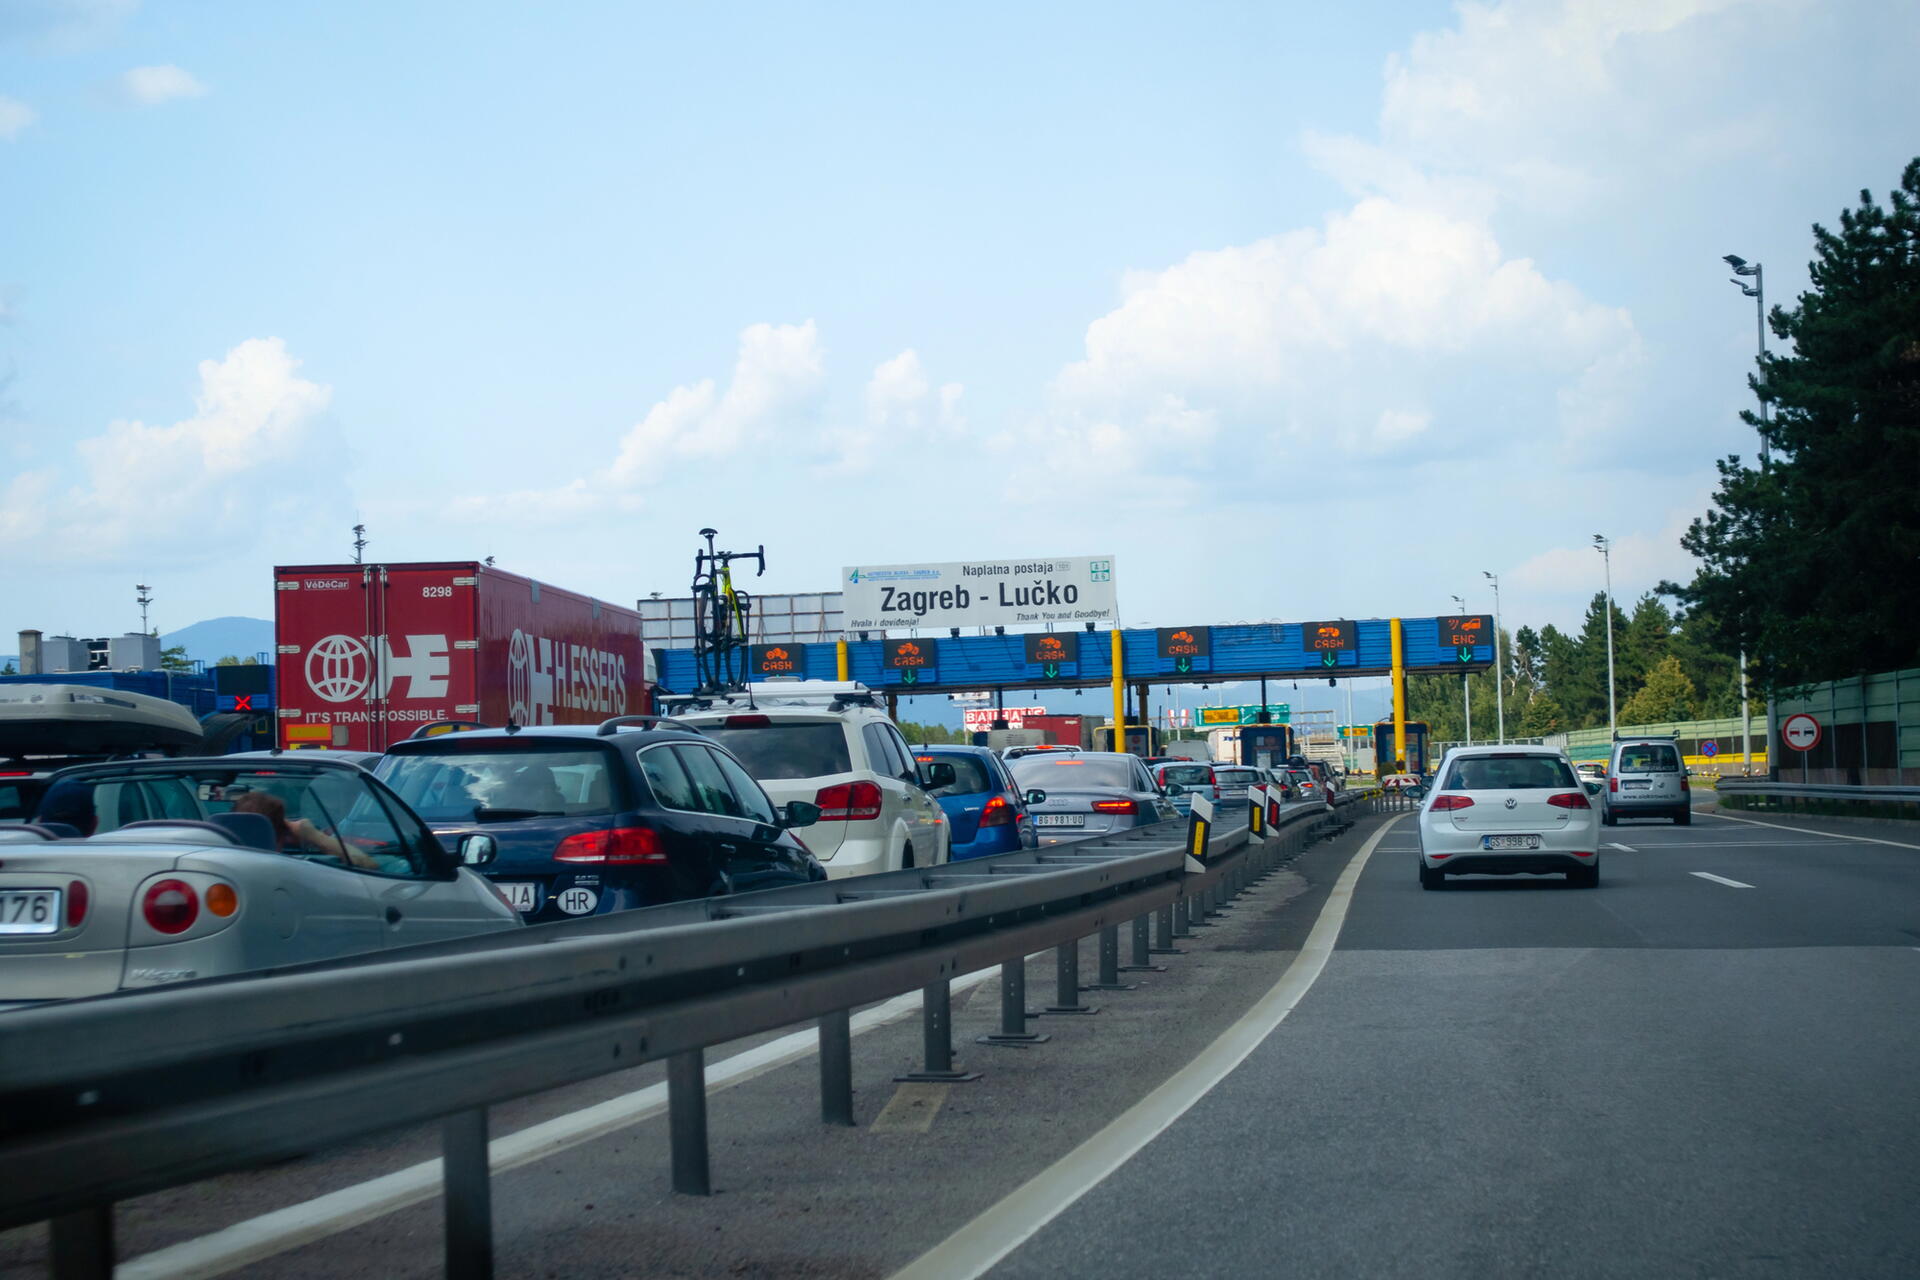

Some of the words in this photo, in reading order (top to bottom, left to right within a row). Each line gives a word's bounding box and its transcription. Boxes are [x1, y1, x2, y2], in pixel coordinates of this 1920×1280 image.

[963, 565, 1010, 577] Naplatna
[1015, 562, 1053, 576] postaja
[305, 580, 348, 589] VéDéCar
[422, 587, 453, 598] 8298
[881, 584, 970, 616] Zagreb
[999, 580, 1079, 607] Lučko
[1016, 612, 1039, 622] Thank
[1041, 612, 1055, 621] You
[1057, 611, 1071, 620] and
[1074, 609, 1111, 620] Goodbye!
[851, 618, 874, 628] Hvala
[1314, 638, 1344, 648] CASH
[1452, 634, 1476, 645] ENC
[1036, 650, 1065, 660] CASH
[1169, 645, 1198, 655] CASH
[762, 660, 792, 671] CASH
[894, 656, 924, 666] CASH
[555, 641, 626, 715] H.ESSERS
[306, 712, 331, 723] IT'S
[1039, 815, 1048, 824] BG
[1490, 837, 1500, 846] GS
[565, 891, 589, 911] HR
